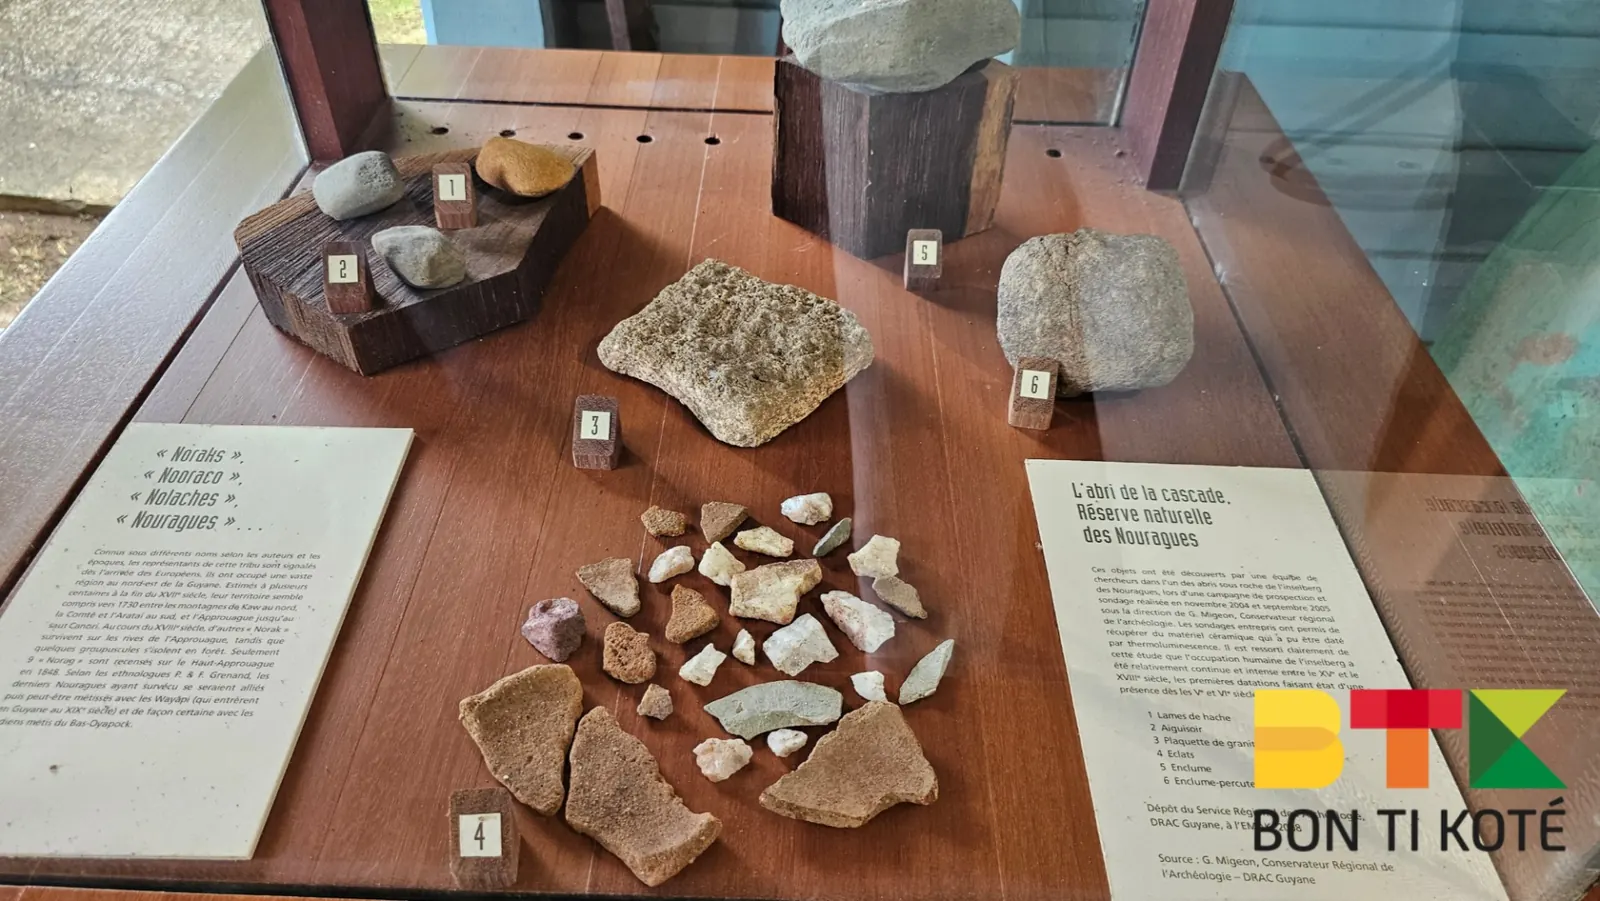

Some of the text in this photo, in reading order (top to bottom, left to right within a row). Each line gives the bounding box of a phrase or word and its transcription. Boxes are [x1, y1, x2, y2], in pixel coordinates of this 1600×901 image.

[449, 179, 454, 196] 1
[921, 244, 928, 261] 5
[339, 259, 347, 278] 2
[1031, 375, 1039, 394] 6
[591, 415, 599, 435] 3
[170, 446, 226, 463] Noraks
[157, 467, 224, 484] Nooraco
[144, 489, 220, 506] Nolaches
[1072, 482, 1116, 500] L'abri
[1120, 484, 1139, 500] de
[1142, 485, 1158, 501] la
[131, 511, 219, 532] Nouragues
[1077, 503, 1213, 525] Réserve naturelle
[1083, 526, 1199, 549] des Nouragues
[94, 548, 125, 556] Connus
[1093, 576, 1139, 584] chercheurs
[1197, 580, 1218, 588] abris
[1277, 583, 1322, 593] l'inselberg
[1096, 586, 1111, 594] des
[1111, 586, 1161, 596] Nouragues,
[1180, 589, 1205, 597] d'une
[1206, 592, 1251, 601] campagne
[1251, 592, 1264, 600] de
[1121, 607, 1131, 615] la
[1133, 608, 1172, 616] direction
[1188, 610, 1198, 618] G.
[1200, 611, 1238, 620] Migeon,
[1239, 613, 1296, 621] Conservateur
[1298, 615, 1335, 624] régional
[105, 634, 119, 642] les
[164, 635, 229, 645] l'Approuague,
[234, 636, 263, 644] tandis
[266, 638, 285, 646] que
[34, 645, 76, 653] quelques
[79, 645, 140, 655] groupuscules
[143, 646, 182, 654] s'isolent
[201, 647, 226, 655] forêt.
[230, 647, 280, 656] Seulement
[1111, 651, 1134, 659] cette
[1136, 652, 1163, 660] étude
[1184, 653, 1241, 664] l'occupation
[1242, 657, 1283, 665] humaine
[1284, 657, 1297, 665] de
[1298, 658, 1347, 669] l'inselberg
[11, 680, 52, 688] derniers
[55, 681, 108, 691] Nouragues
[110, 683, 139, 691] ayant
[240, 684, 265, 692] alliés
[1144, 675, 1172, 684] siècle,
[1173, 676, 1187, 684] les
[1188, 676, 1235, 686] premières
[1237, 679, 1281, 688] datations
[1282, 679, 1314, 689] faisant
[1315, 681, 1335, 690] état
[3, 693, 25, 701] puis
[114, 696, 137, 704] avec
[138, 694, 153, 703] les
[192, 695, 212, 705] (qui
[1157, 711, 1188, 720] Lames
[1188, 712, 1201, 721] de
[1202, 712, 1231, 722] hache
[1149, 723, 1202, 734] 2 Aiguisoir
[1153, 735, 1160, 745] 3
[1163, 736, 1211, 747] Plaquette
[1211, 738, 1225, 747] de
[1156, 749, 1195, 759] 4 Eclats
[1159, 762, 1212, 773] 5 Enclume
[1163, 776, 1170, 785] 6
[1147, 803, 1178, 815] Dépôt
[1180, 805, 1195, 814] du
[1196, 805, 1231, 816] Service
[1150, 818, 1180, 828] DRAC
[1181, 818, 1224, 831] Guyane,
[1226, 820, 1233, 830] à
[474, 822, 485, 850] 4
[1158, 854, 1193, 865] Source
[1201, 855, 1214, 865] G.
[1215, 856, 1260, 868] Migeon,
[1261, 857, 1330, 869] Conservateur
[1331, 860, 1379, 873] Régional
[1380, 862, 1395, 872] de
[1162, 869, 1232, 882] l'Archéologie
[1242, 872, 1274, 883] DRAC
[1275, 873, 1316, 886] Guyane
